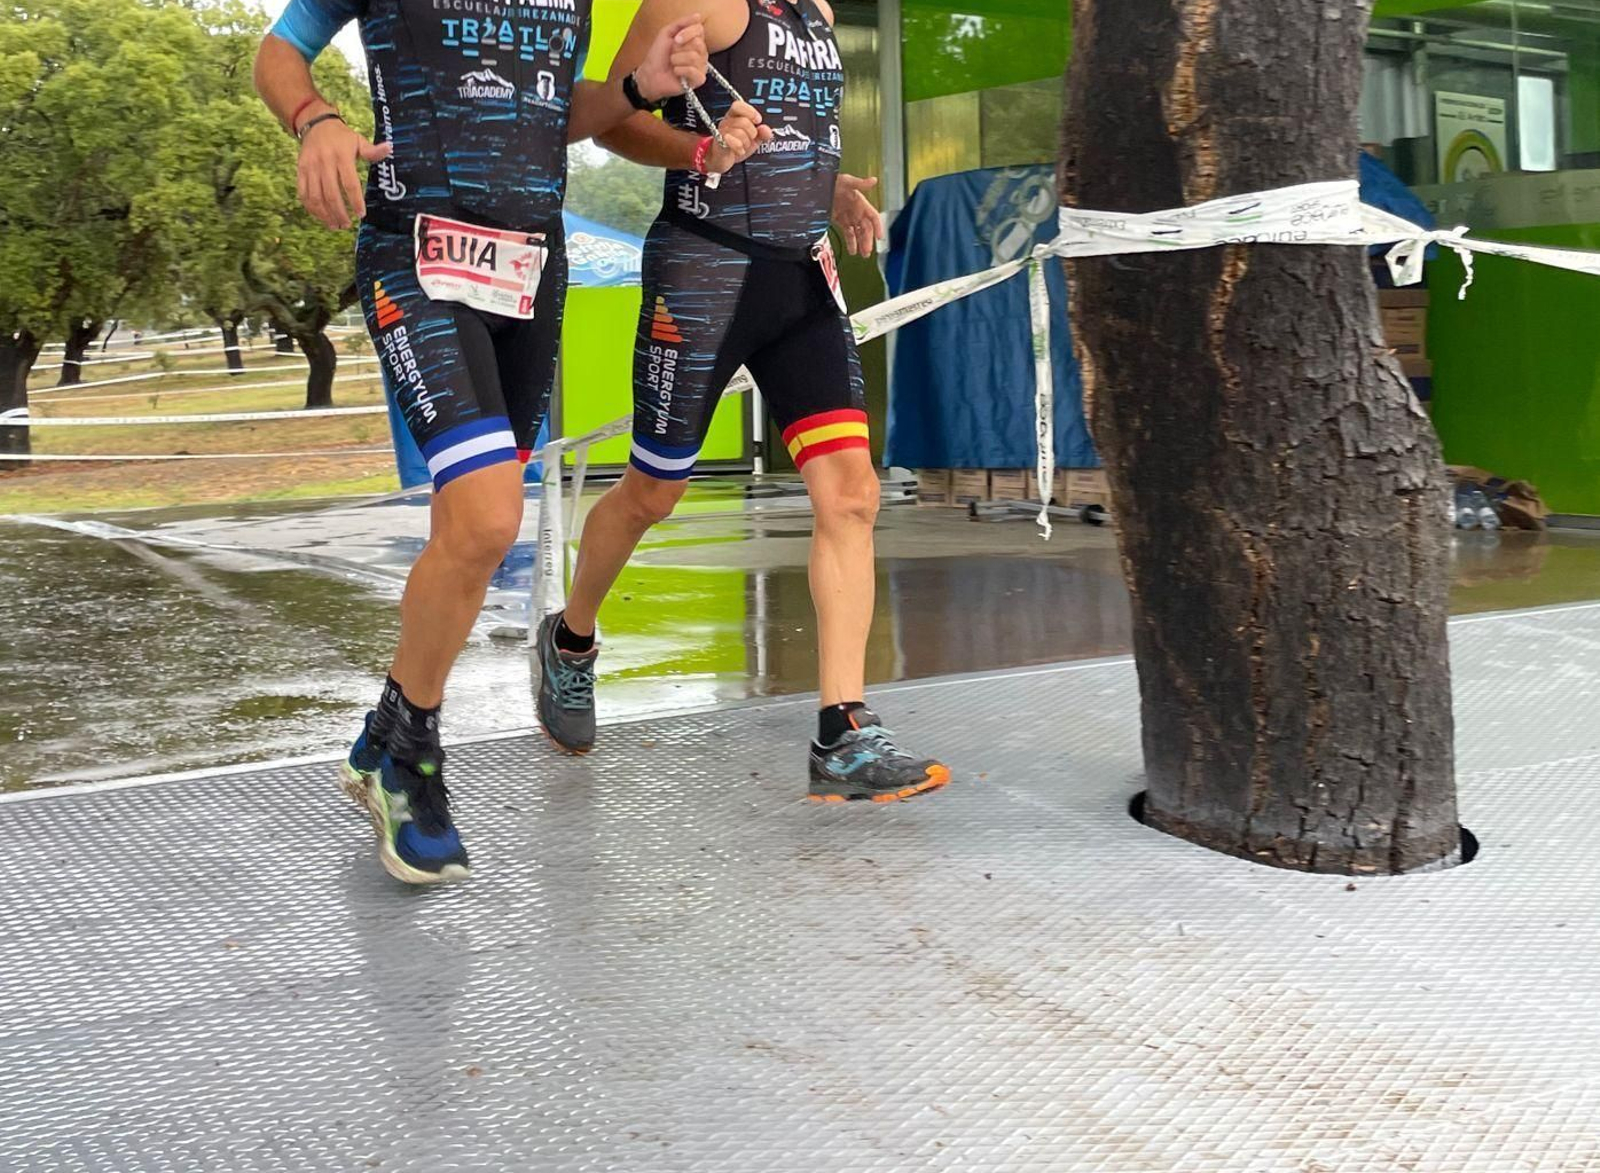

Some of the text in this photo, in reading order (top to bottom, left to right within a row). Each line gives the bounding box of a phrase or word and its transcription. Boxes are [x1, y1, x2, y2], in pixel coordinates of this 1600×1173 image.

[747, 57, 802, 76] ESCUELA
[767, 22, 843, 70] PARRA
[457, 85, 515, 100] TRIACADEMY
[420, 235, 497, 272] GUIA
[382, 332, 407, 383] SPORT
[392, 325, 438, 424] ENERGYUM
[647, 345, 662, 392] SPORT
[654, 349, 678, 435] ENERGYUM
